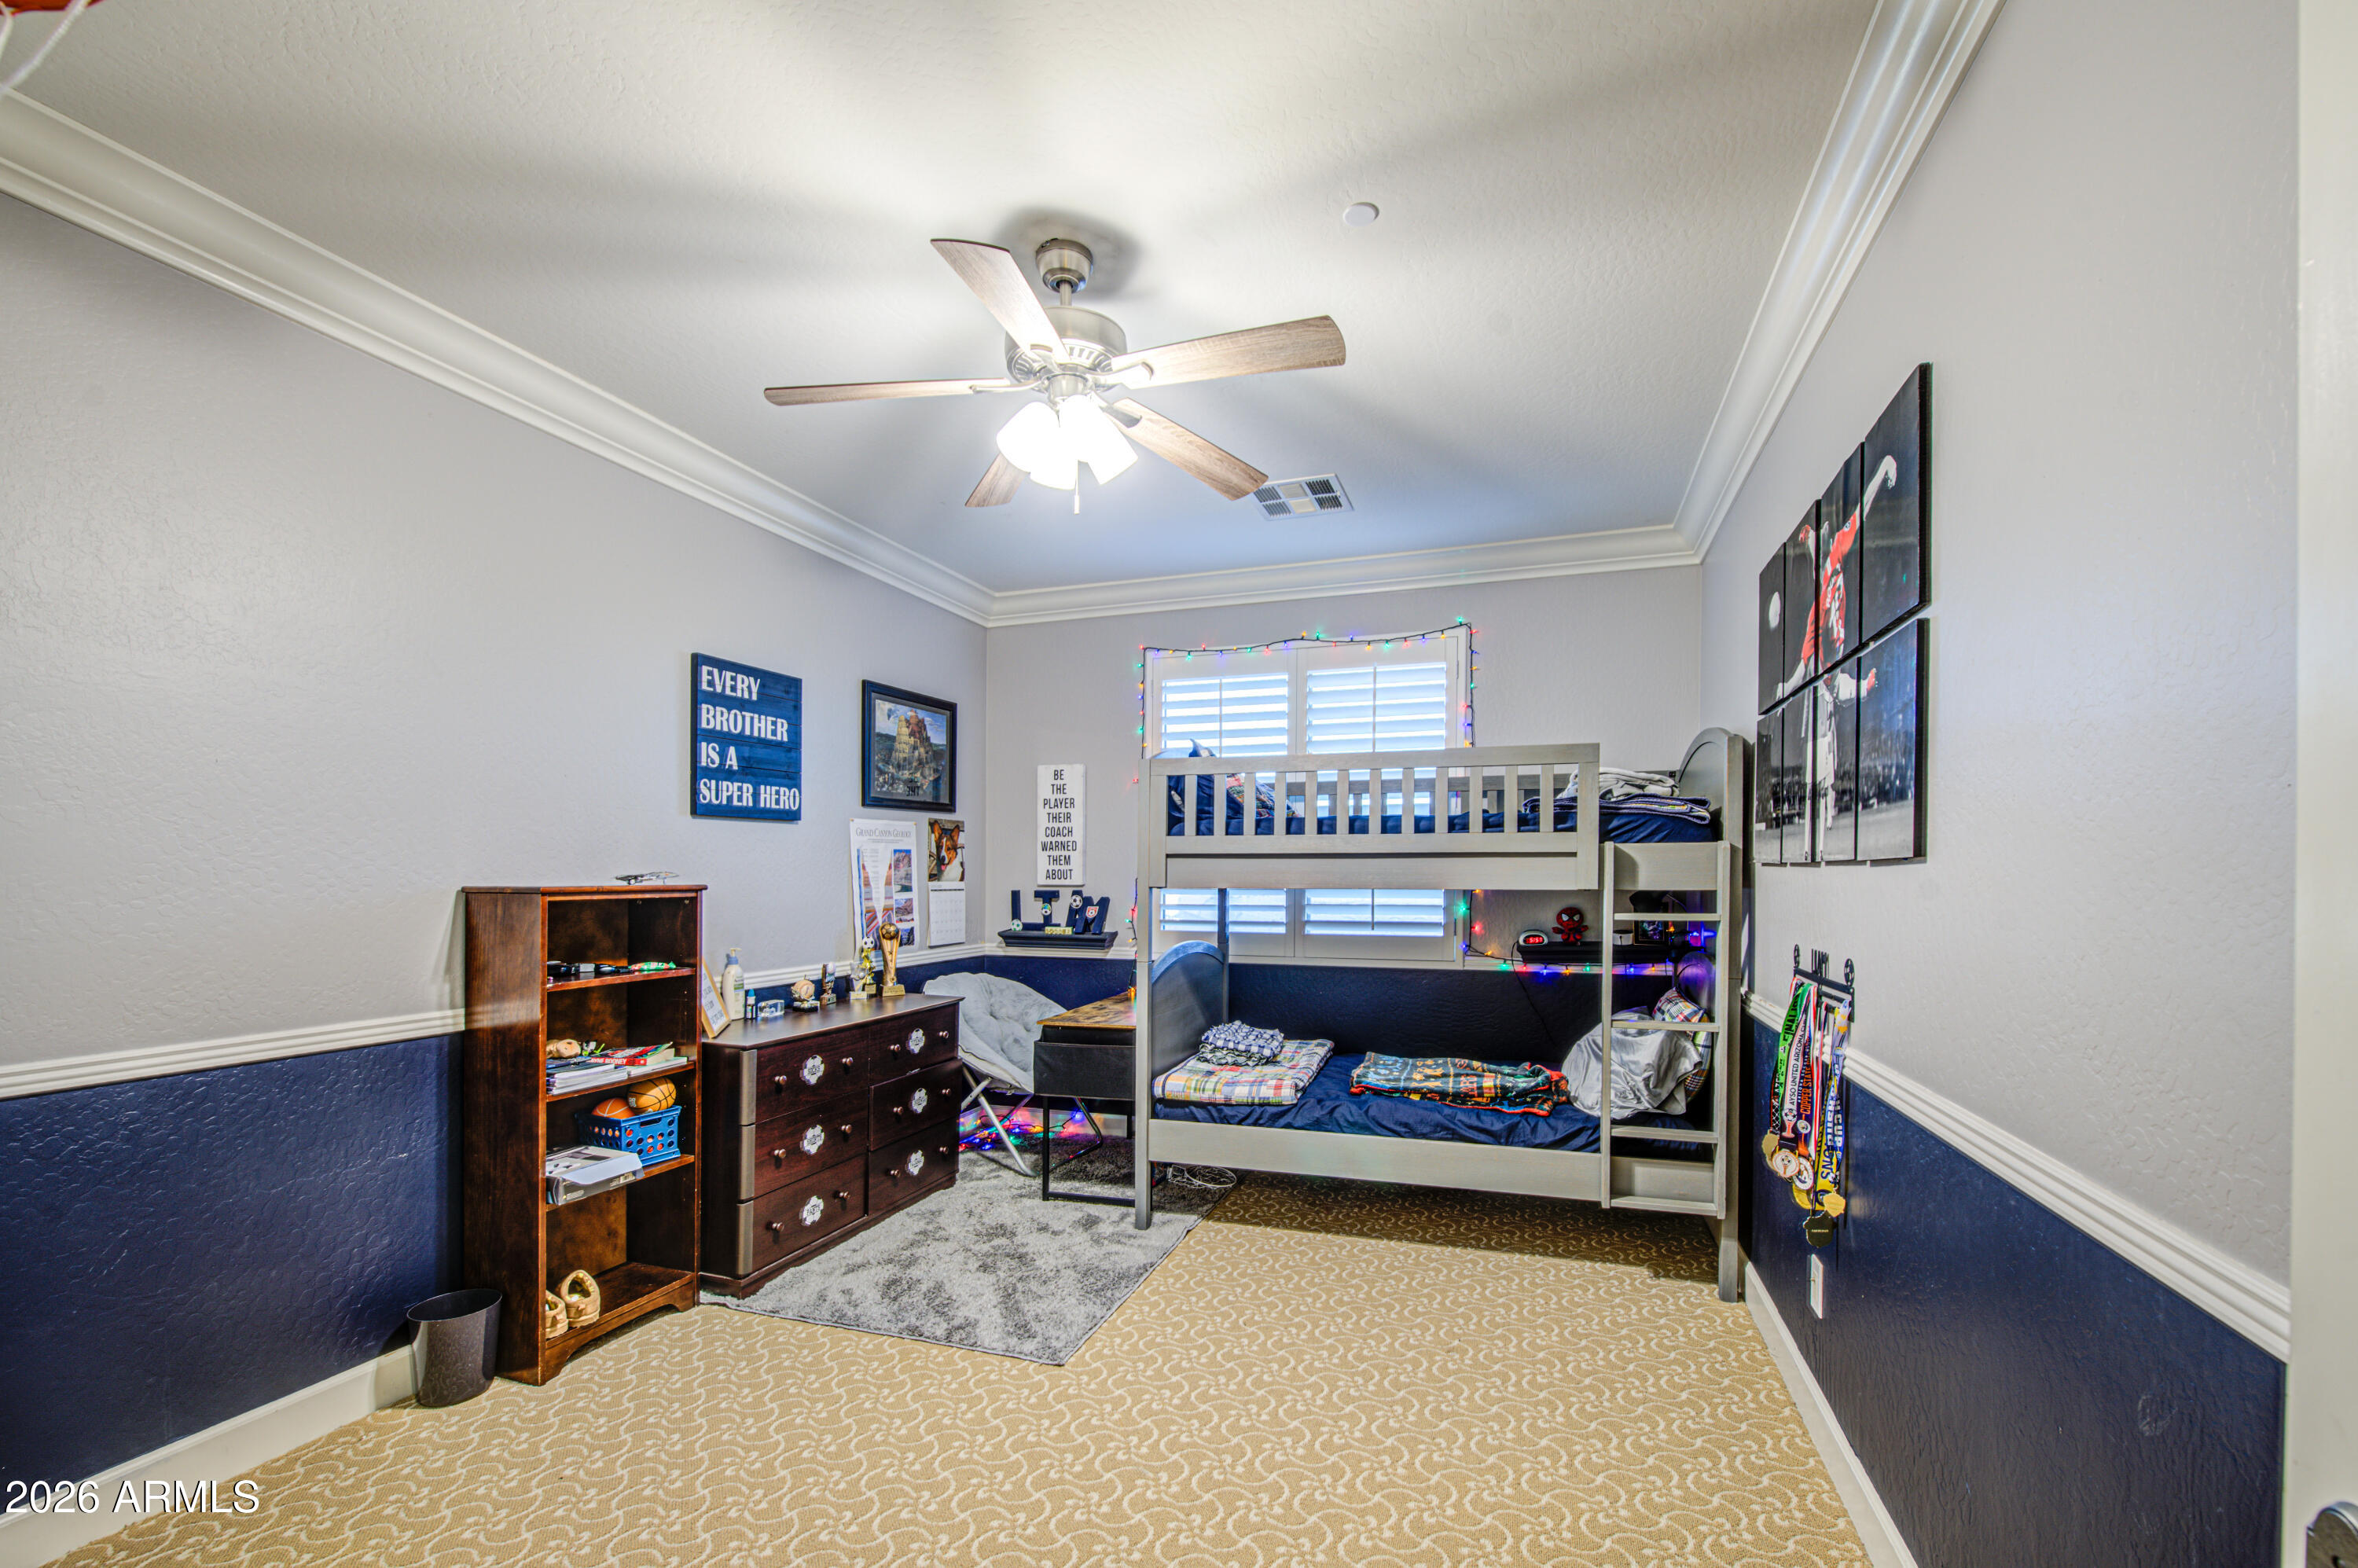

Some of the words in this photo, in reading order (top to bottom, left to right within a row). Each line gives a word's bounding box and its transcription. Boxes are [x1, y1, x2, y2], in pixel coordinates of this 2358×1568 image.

[700, 665, 761, 701] EVERY
[701, 703, 789, 742] BROTHER
[700, 741, 721, 769] IS
[725, 746, 739, 770] A
[1053, 769, 1065, 780] BE
[699, 778, 754, 806] SUPER
[759, 784, 800, 811] HERO
[1051, 784, 1067, 795] THE
[1043, 798, 1075, 810] PLAYER
[1046, 812, 1071, 823] THEIR
[855, 827, 874, 837] GRAND
[874, 828, 893, 838] CANYON
[1045, 826, 1073, 838] COACH
[1041, 840, 1078, 852] WARNED
[1047, 855, 1071, 866] THEM
[1045, 868, 1074, 880] ABOUT
[1794, 1034, 1805, 1063] ARIZONA
[1791, 1063, 1799, 1087] UNITED
[1803, 1066, 1813, 1087] STATE
[1800, 1088, 1812, 1114] COPPER
